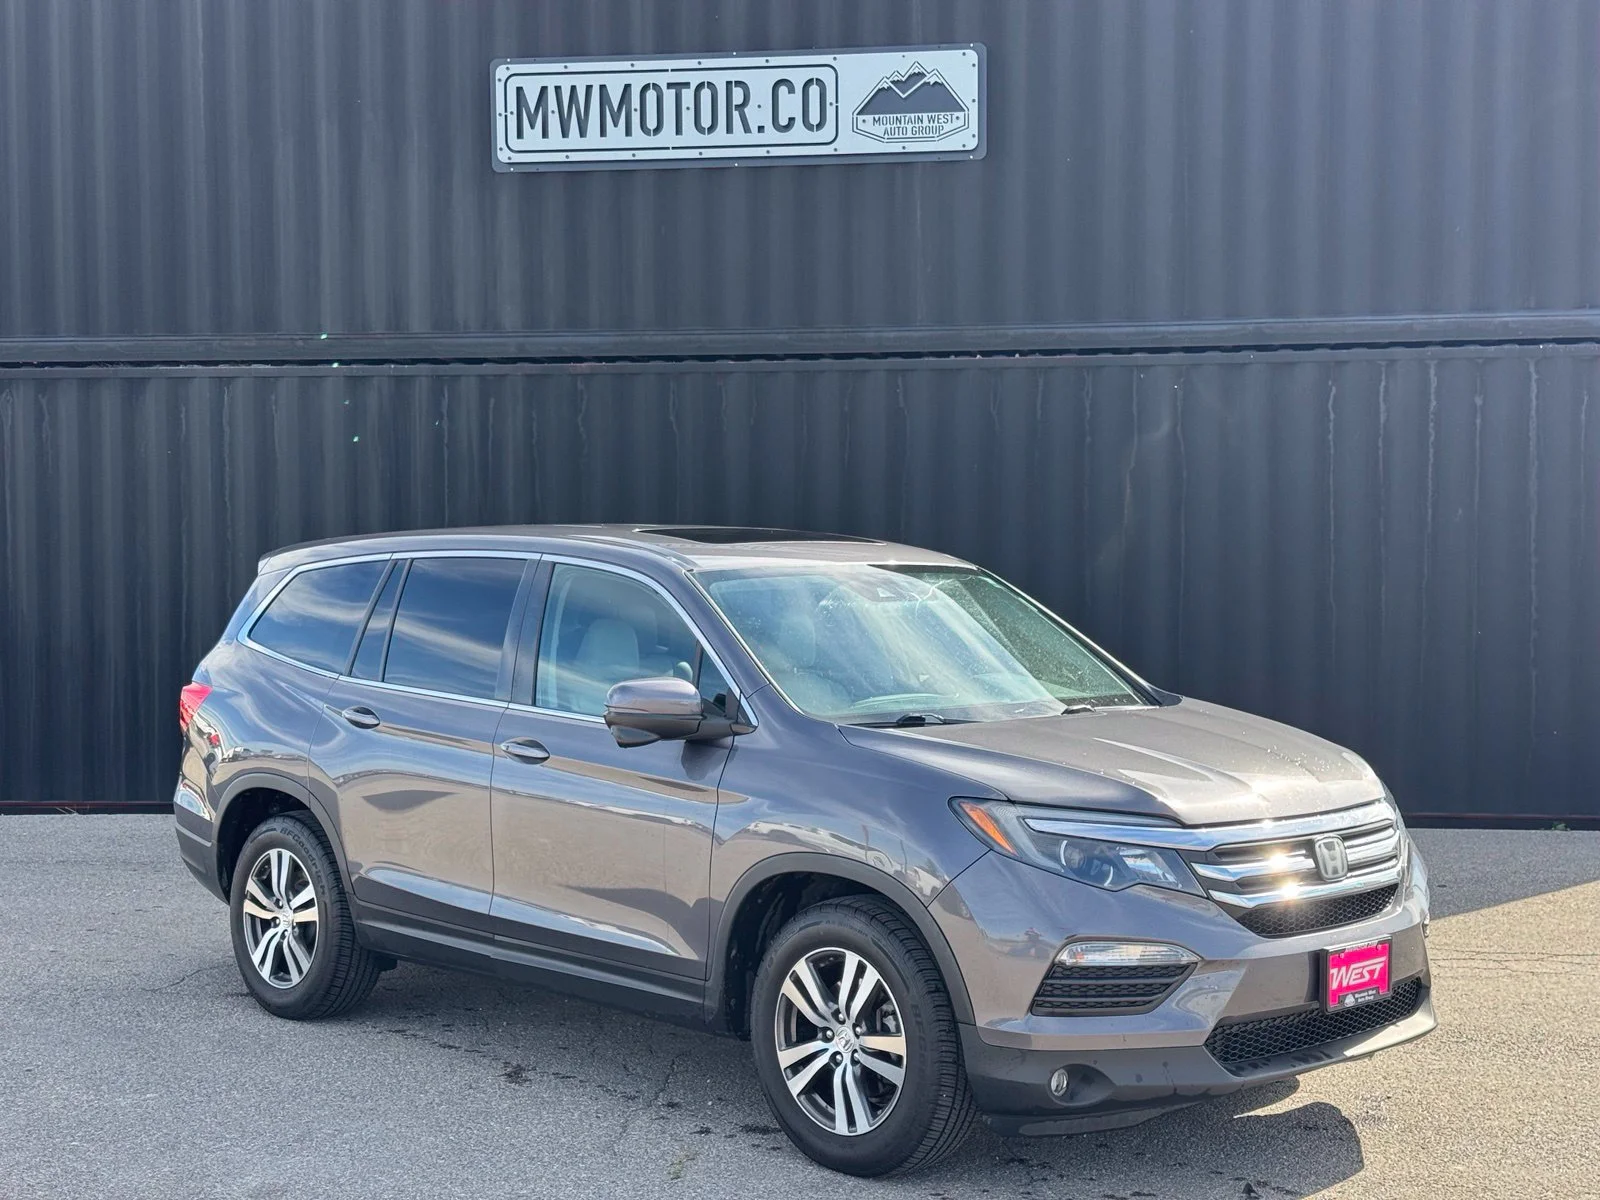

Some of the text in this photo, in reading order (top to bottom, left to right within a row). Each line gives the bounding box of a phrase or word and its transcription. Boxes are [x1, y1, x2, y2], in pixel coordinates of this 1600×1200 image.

[516, 77, 827, 139] MWMOTOR.CO
[872, 113, 955, 126] MOUNTAIN WEST
[883, 125, 944, 137] AUTO GROUP
[1330, 956, 1387, 990] WEST
